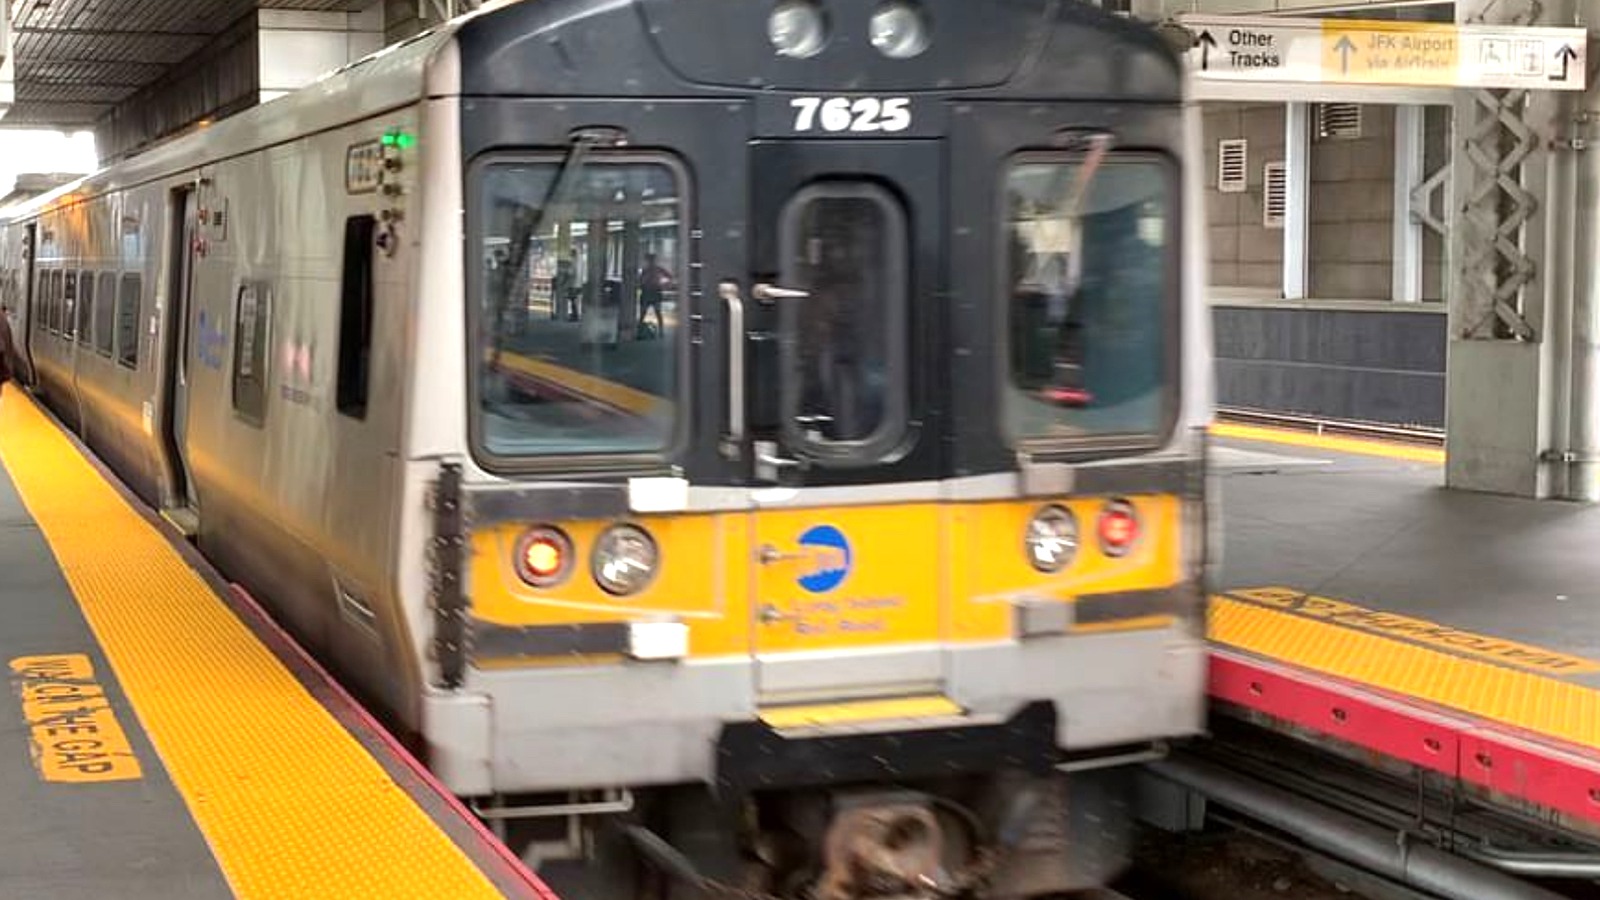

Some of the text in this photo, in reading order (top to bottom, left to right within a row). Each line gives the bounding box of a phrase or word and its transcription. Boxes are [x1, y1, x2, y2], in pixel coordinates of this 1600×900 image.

[1229, 29, 1274, 46] Other
[1367, 34, 1453, 50] JFK Airport
[1229, 50, 1280, 68] Tracks
[790, 97, 911, 131] 7625
[53, 739, 113, 774] GAP
